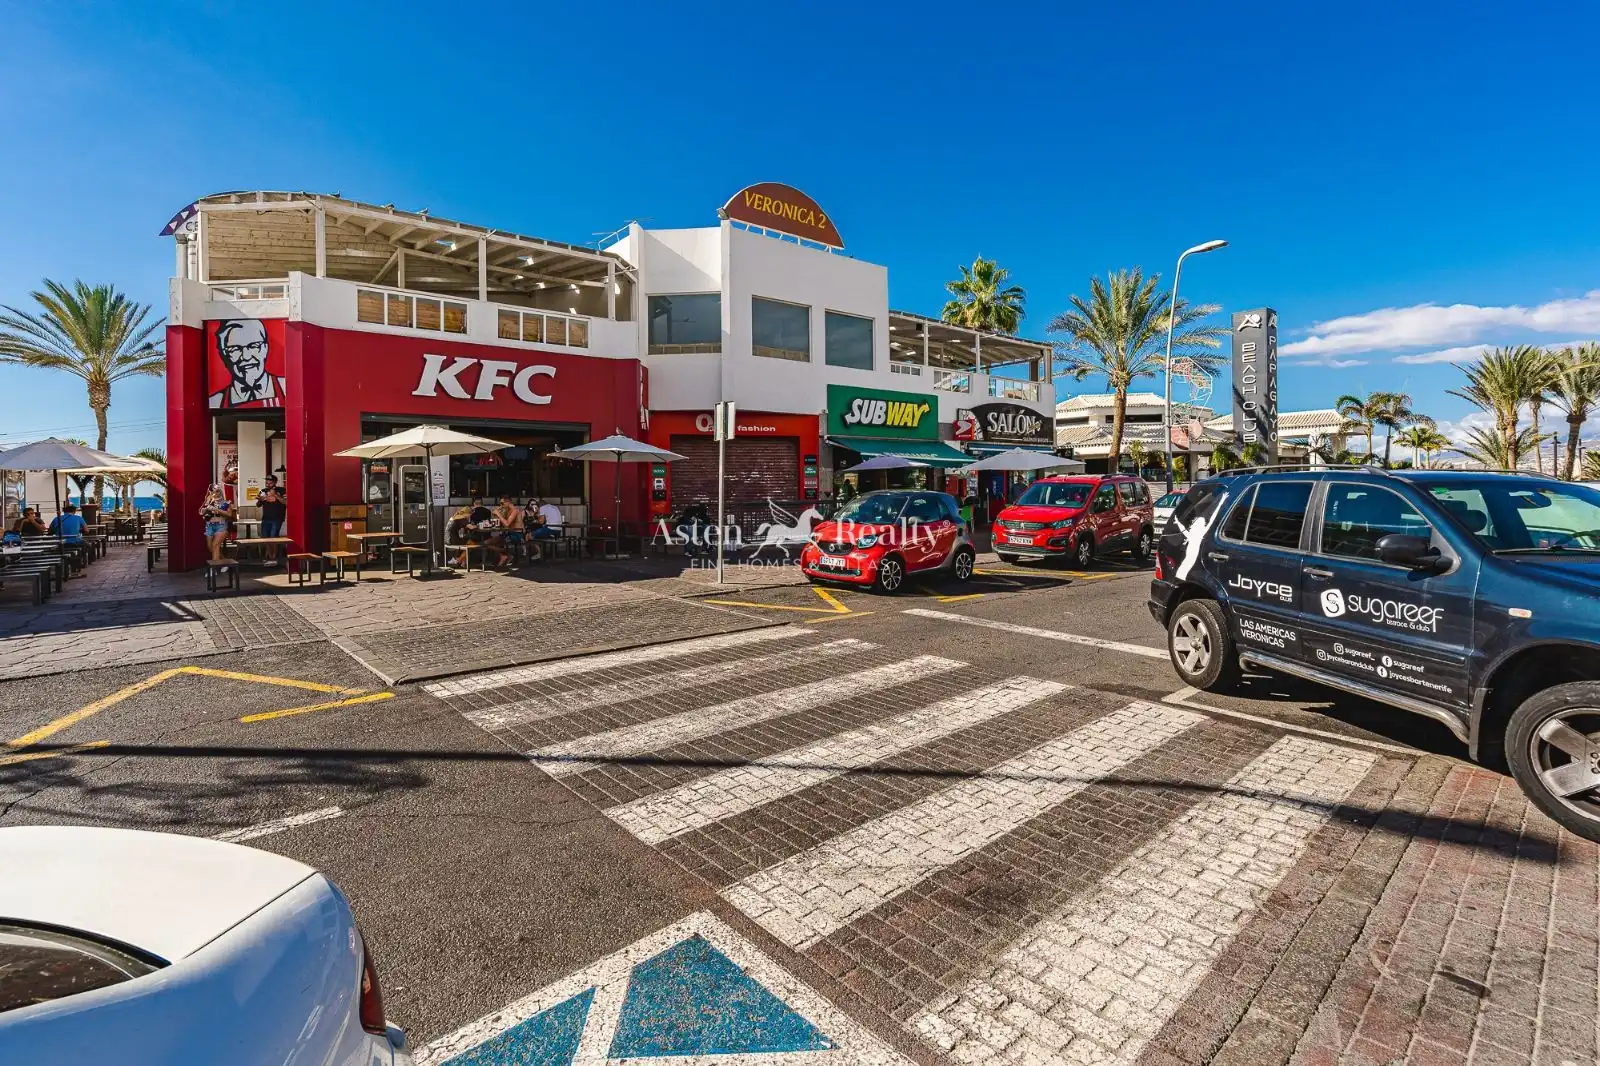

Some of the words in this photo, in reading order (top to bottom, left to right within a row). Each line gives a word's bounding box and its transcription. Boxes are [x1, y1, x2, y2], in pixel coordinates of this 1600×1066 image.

[744, 191, 815, 226] VERONICA
[818, 213, 828, 229] 2
[411, 353, 557, 405] KFC
[1241, 341, 1257, 395] BEACH
[844, 398, 930, 428] SUBWAY
[987, 410, 1037, 435] SALÓN
[1242, 401, 1257, 443] CLUB
[736, 424, 776, 433] fashion
[1229, 574, 1293, 597] Joyce
[1348, 595, 1445, 632] sugareef
[1240, 618, 1254, 630] LAS
[1255, 622, 1297, 641] AMERICAS
[1241, 628, 1285, 648] VERONICAS
[1416, 623, 1430, 633] club
[1393, 660, 1425, 673] sugareef
